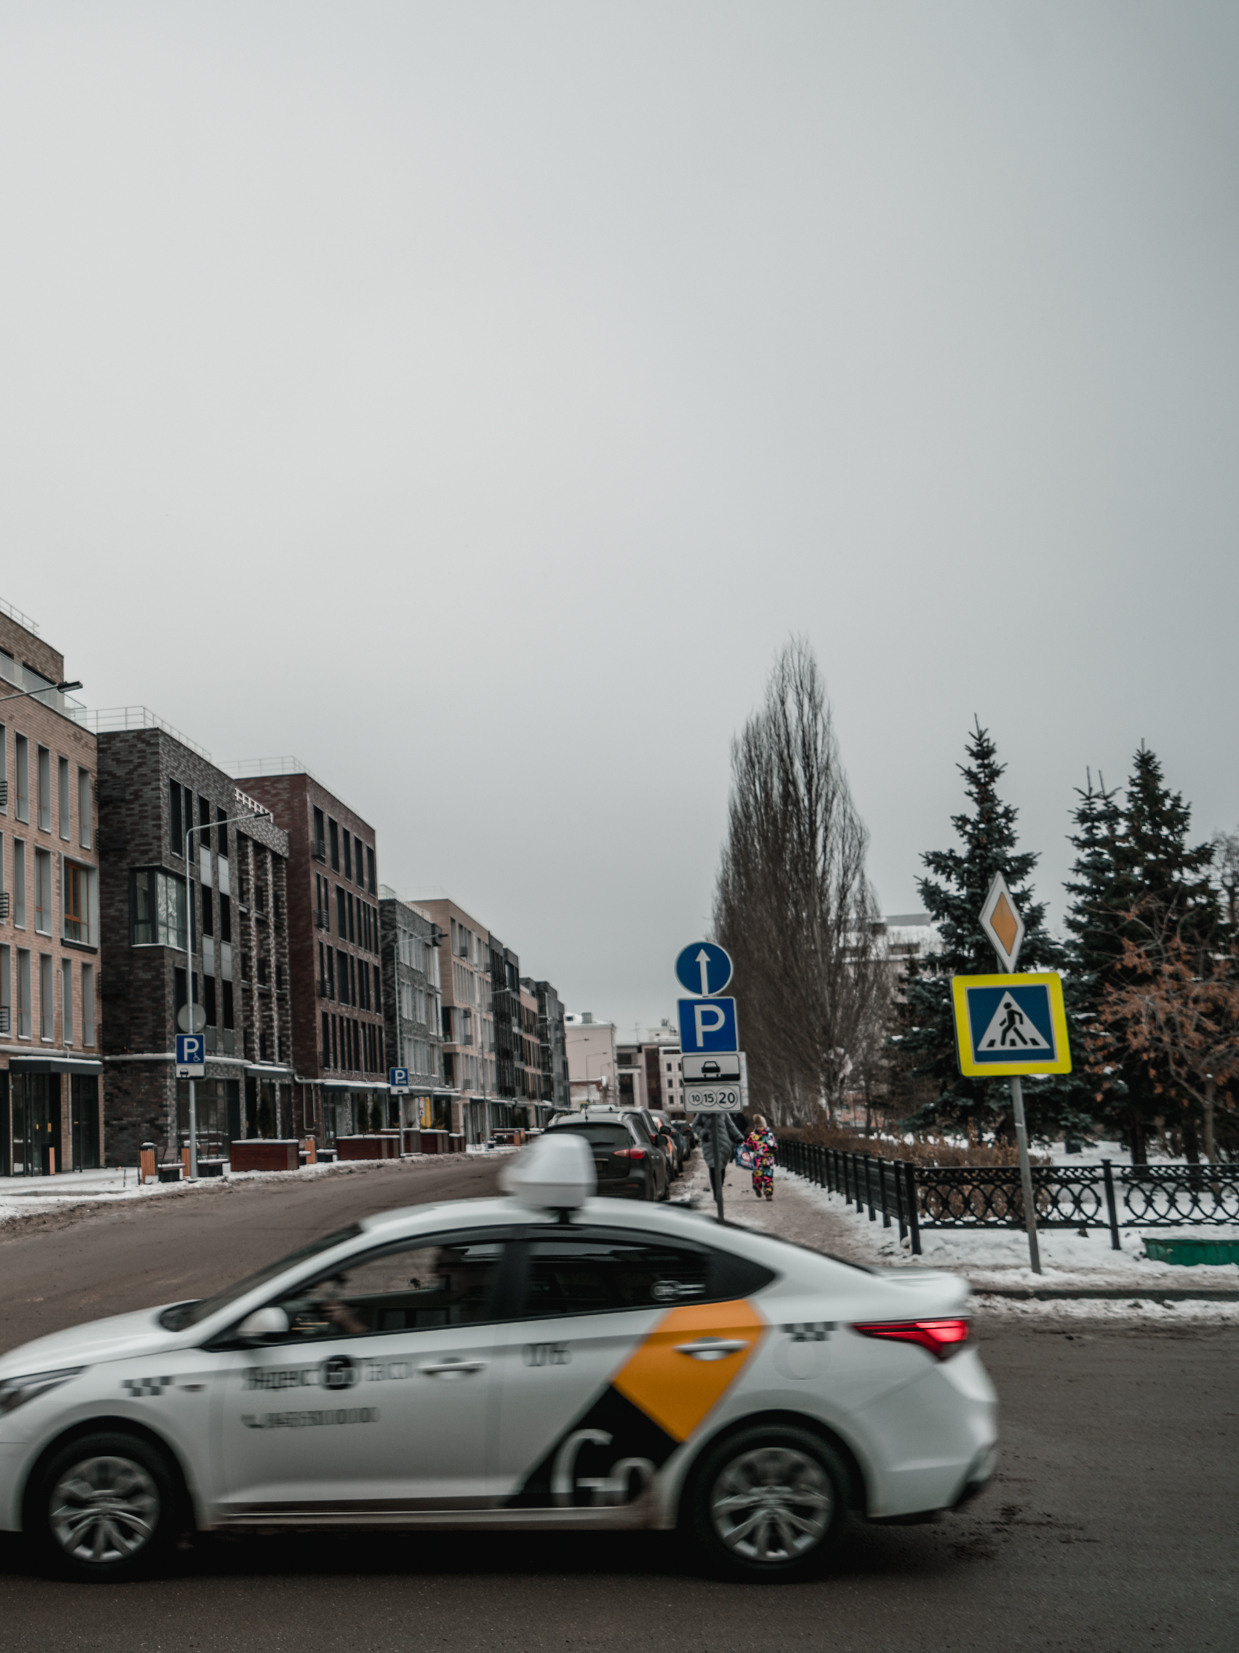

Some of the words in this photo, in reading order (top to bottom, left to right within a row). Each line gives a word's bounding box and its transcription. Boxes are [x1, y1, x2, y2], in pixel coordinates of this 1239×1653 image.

[694, 1004, 725, 1047] P
[183, 1037, 199, 1061] P
[395, 1070, 406, 1084] P
[703, 1093, 714, 1103] 15
[718, 1092, 736, 1104] 20
